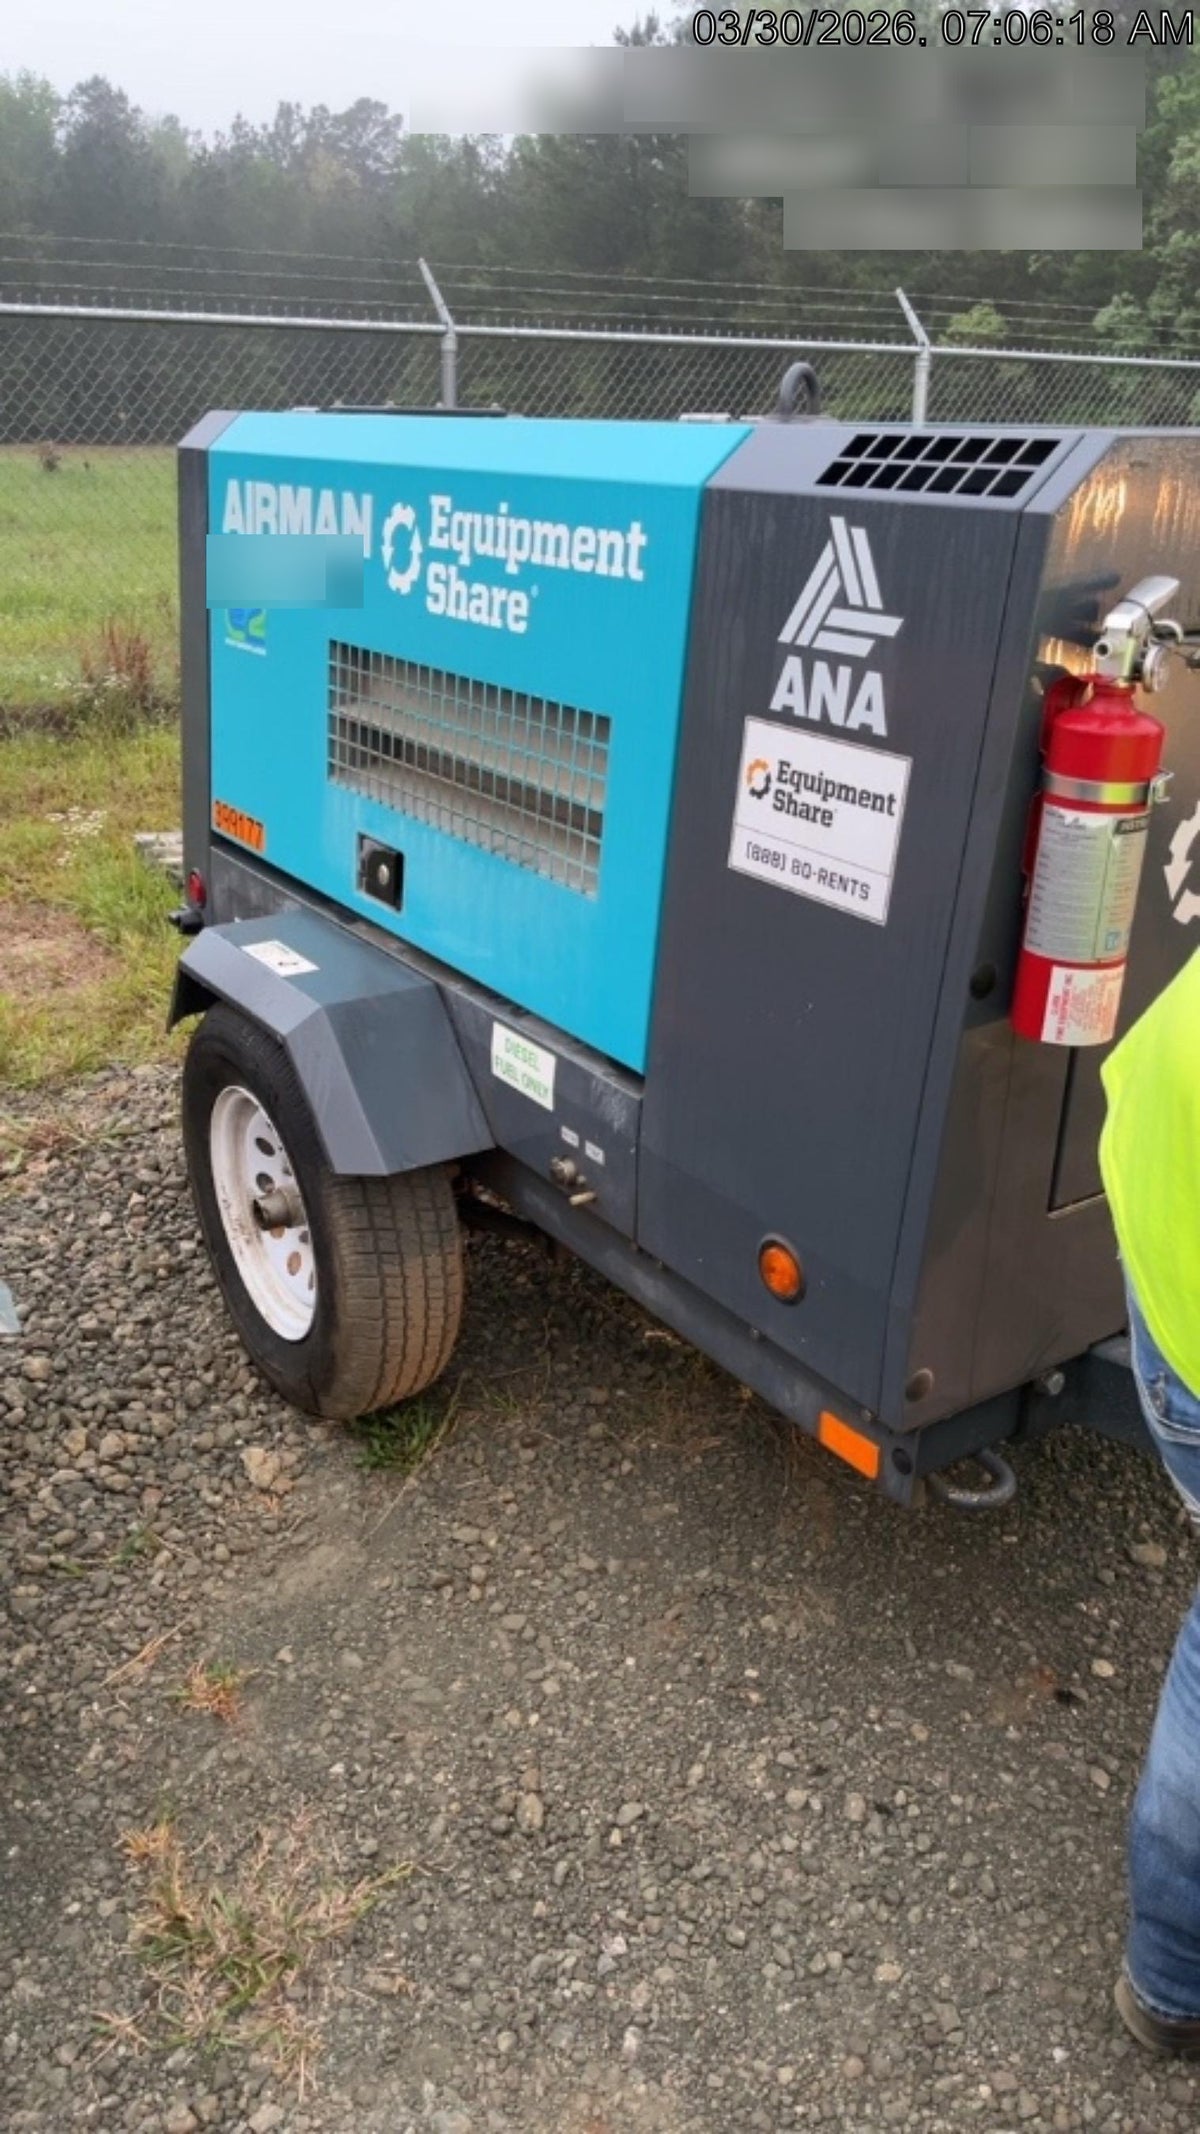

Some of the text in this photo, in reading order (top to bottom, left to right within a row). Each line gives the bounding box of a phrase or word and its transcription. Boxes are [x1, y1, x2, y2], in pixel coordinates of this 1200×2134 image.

[223, 479, 373, 558] AIRMAN
[428, 494, 648, 582] Equipment
[425, 561, 530, 634] Share
[769, 655, 888, 737] ANA
[772, 788, 834, 828] Share
[776, 759, 897, 816] Equipment
[495, 1054, 549, 1099] FUEL ONLY
[505, 1037, 541, 1072] DIESEL
